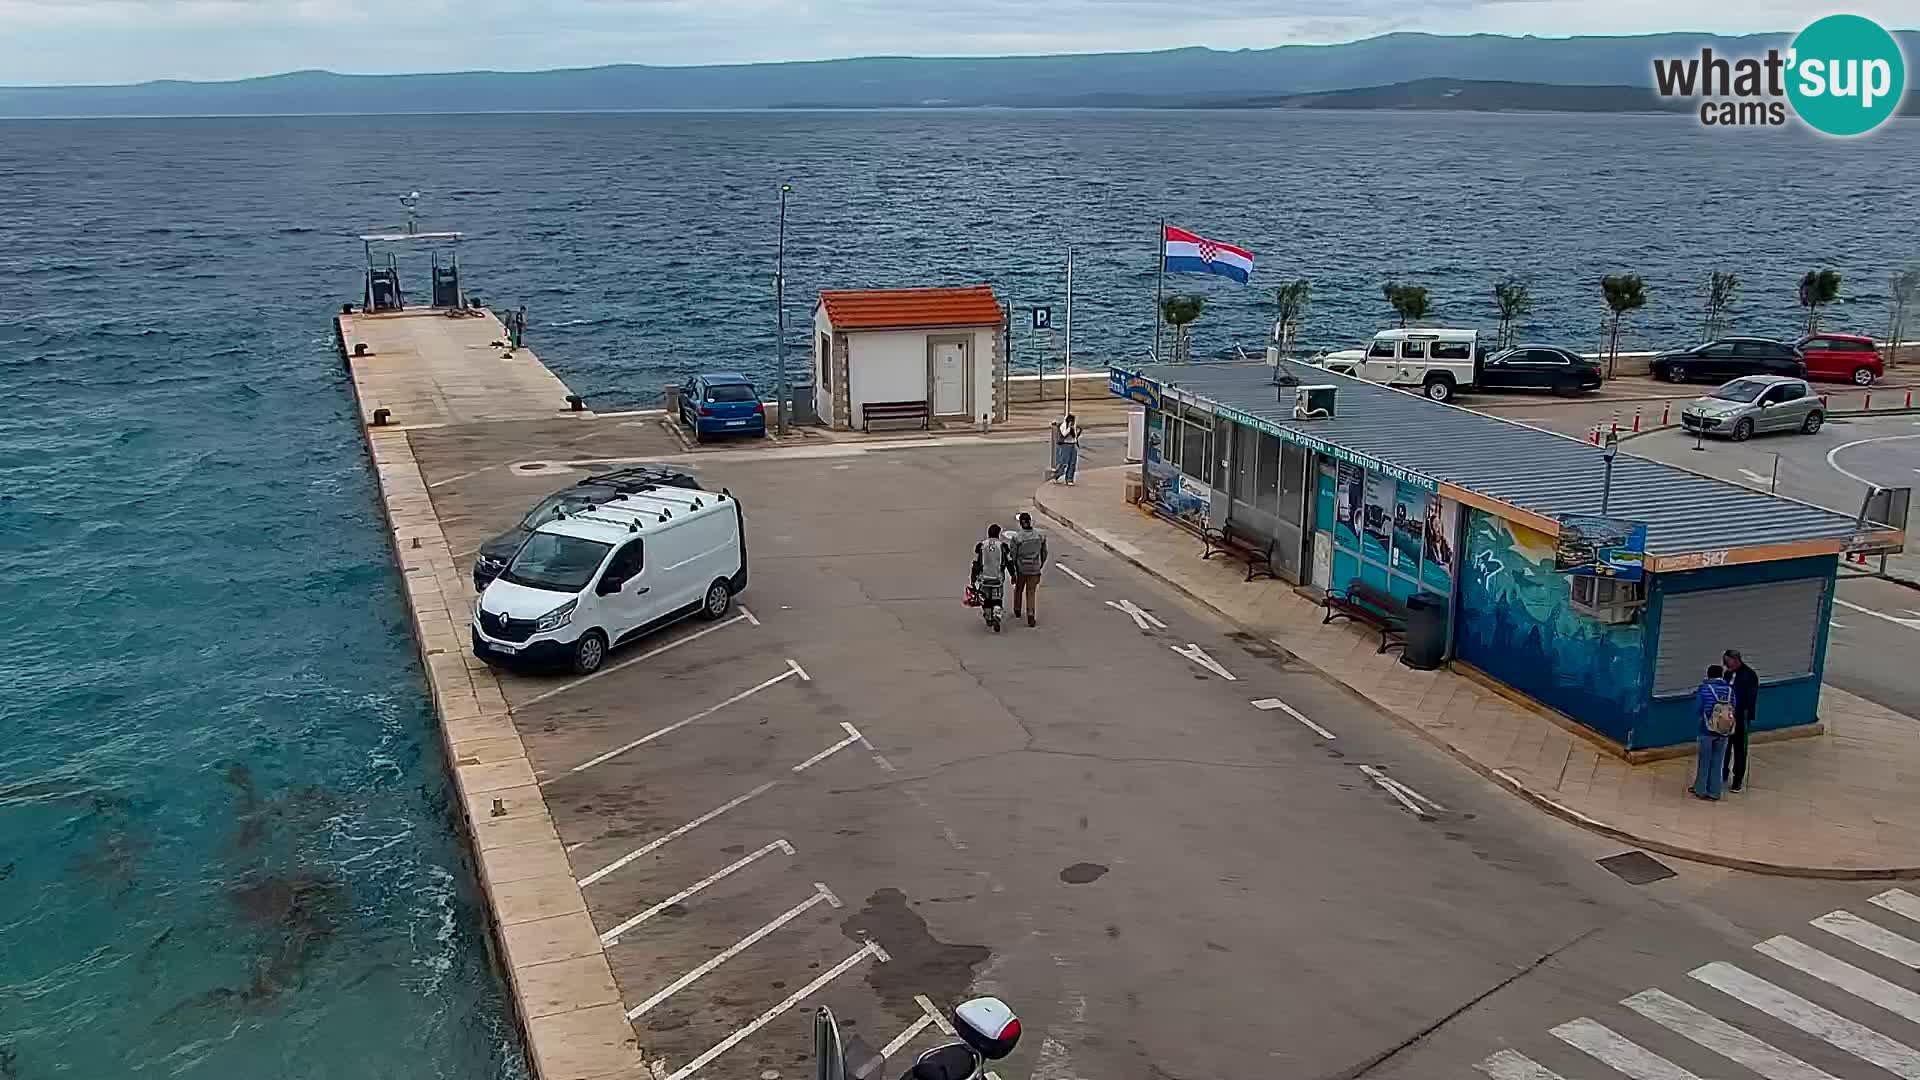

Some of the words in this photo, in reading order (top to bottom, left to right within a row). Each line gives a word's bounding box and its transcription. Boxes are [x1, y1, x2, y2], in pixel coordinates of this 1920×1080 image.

[1036, 309, 1048, 326] P
[1295, 434, 1324, 452] POSTAJA
[1334, 447, 1348, 461] BUS
[1349, 452, 1380, 473] STATION
[1381, 463, 1407, 482] TICKET
[1407, 473, 1434, 491] OFFICE
